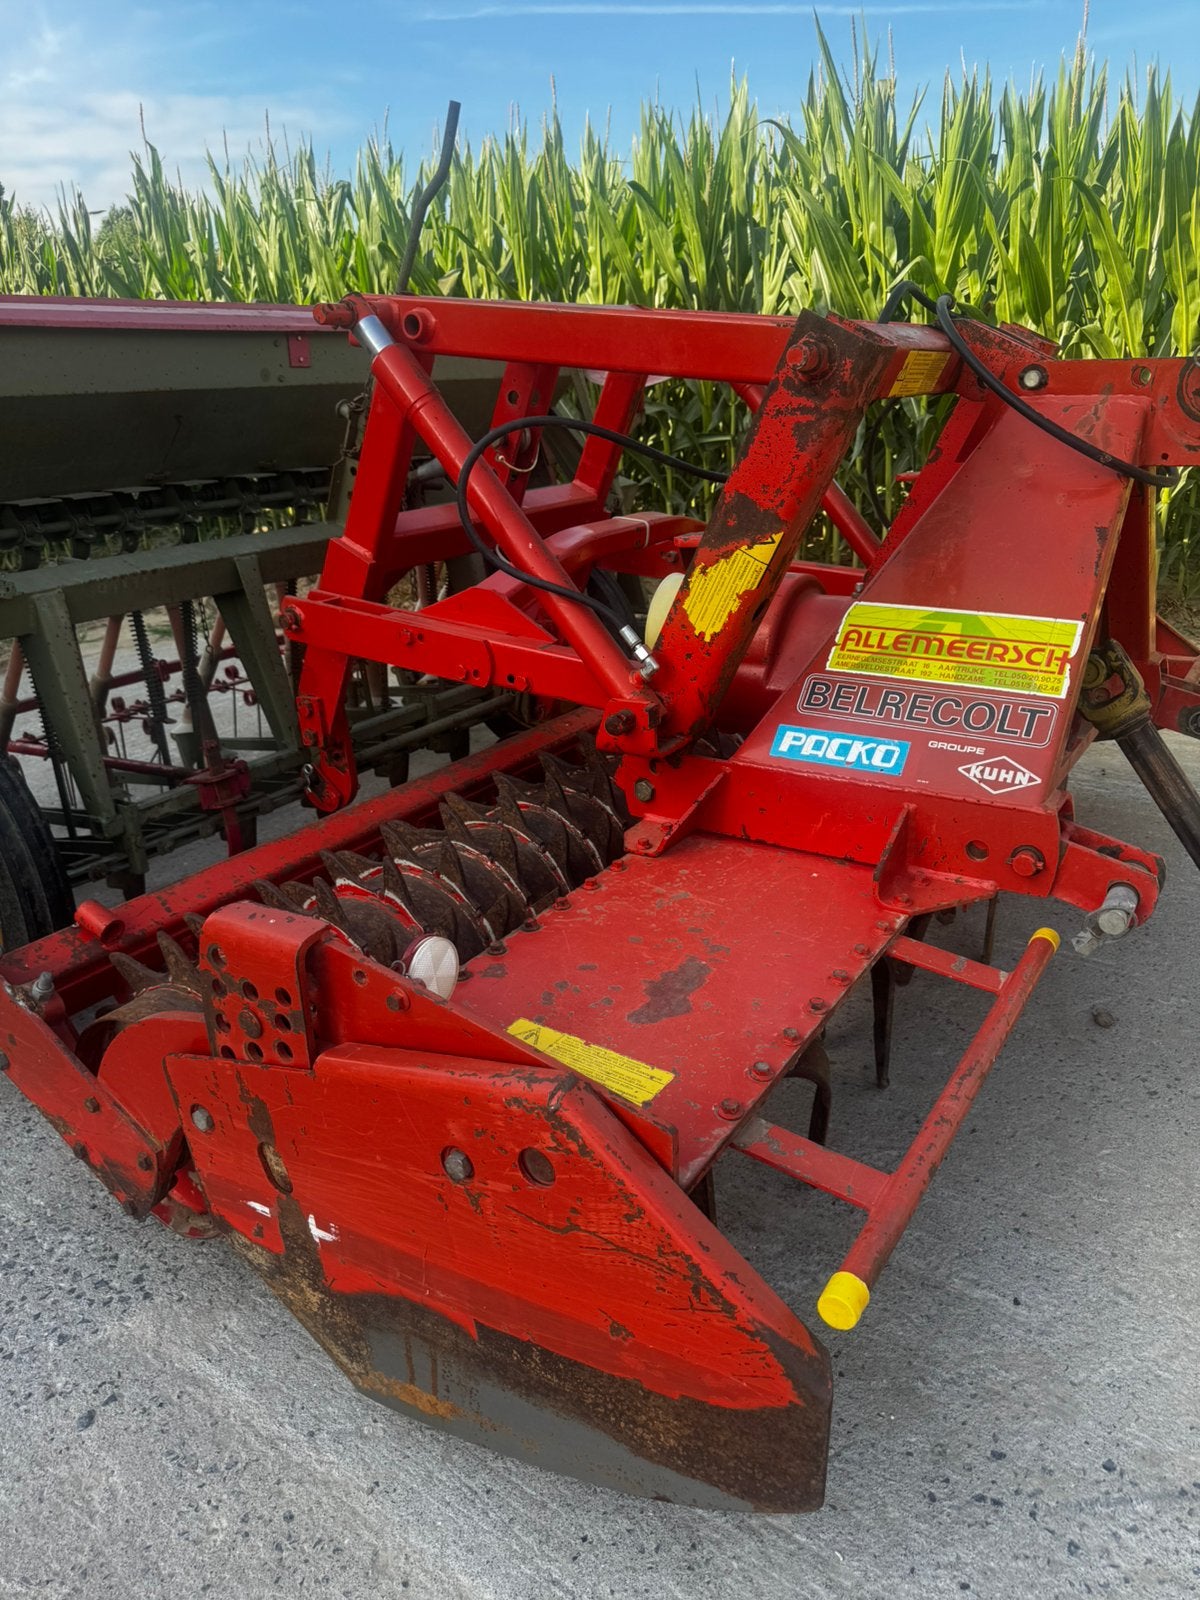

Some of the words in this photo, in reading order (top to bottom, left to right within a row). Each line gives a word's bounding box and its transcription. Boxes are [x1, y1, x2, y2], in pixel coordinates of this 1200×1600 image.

[839, 629, 1071, 676] ALLEMEERSCH
[920, 669, 932, 677] 192
[939, 671, 985, 683] HANDZAME
[937, 664, 985, 675] AARTRIJKE
[803, 679, 1051, 739] BELRECOLT
[776, 730, 900, 769] PACKO
[927, 739, 987, 756] GROUPE
[967, 763, 1032, 787] KUHN
